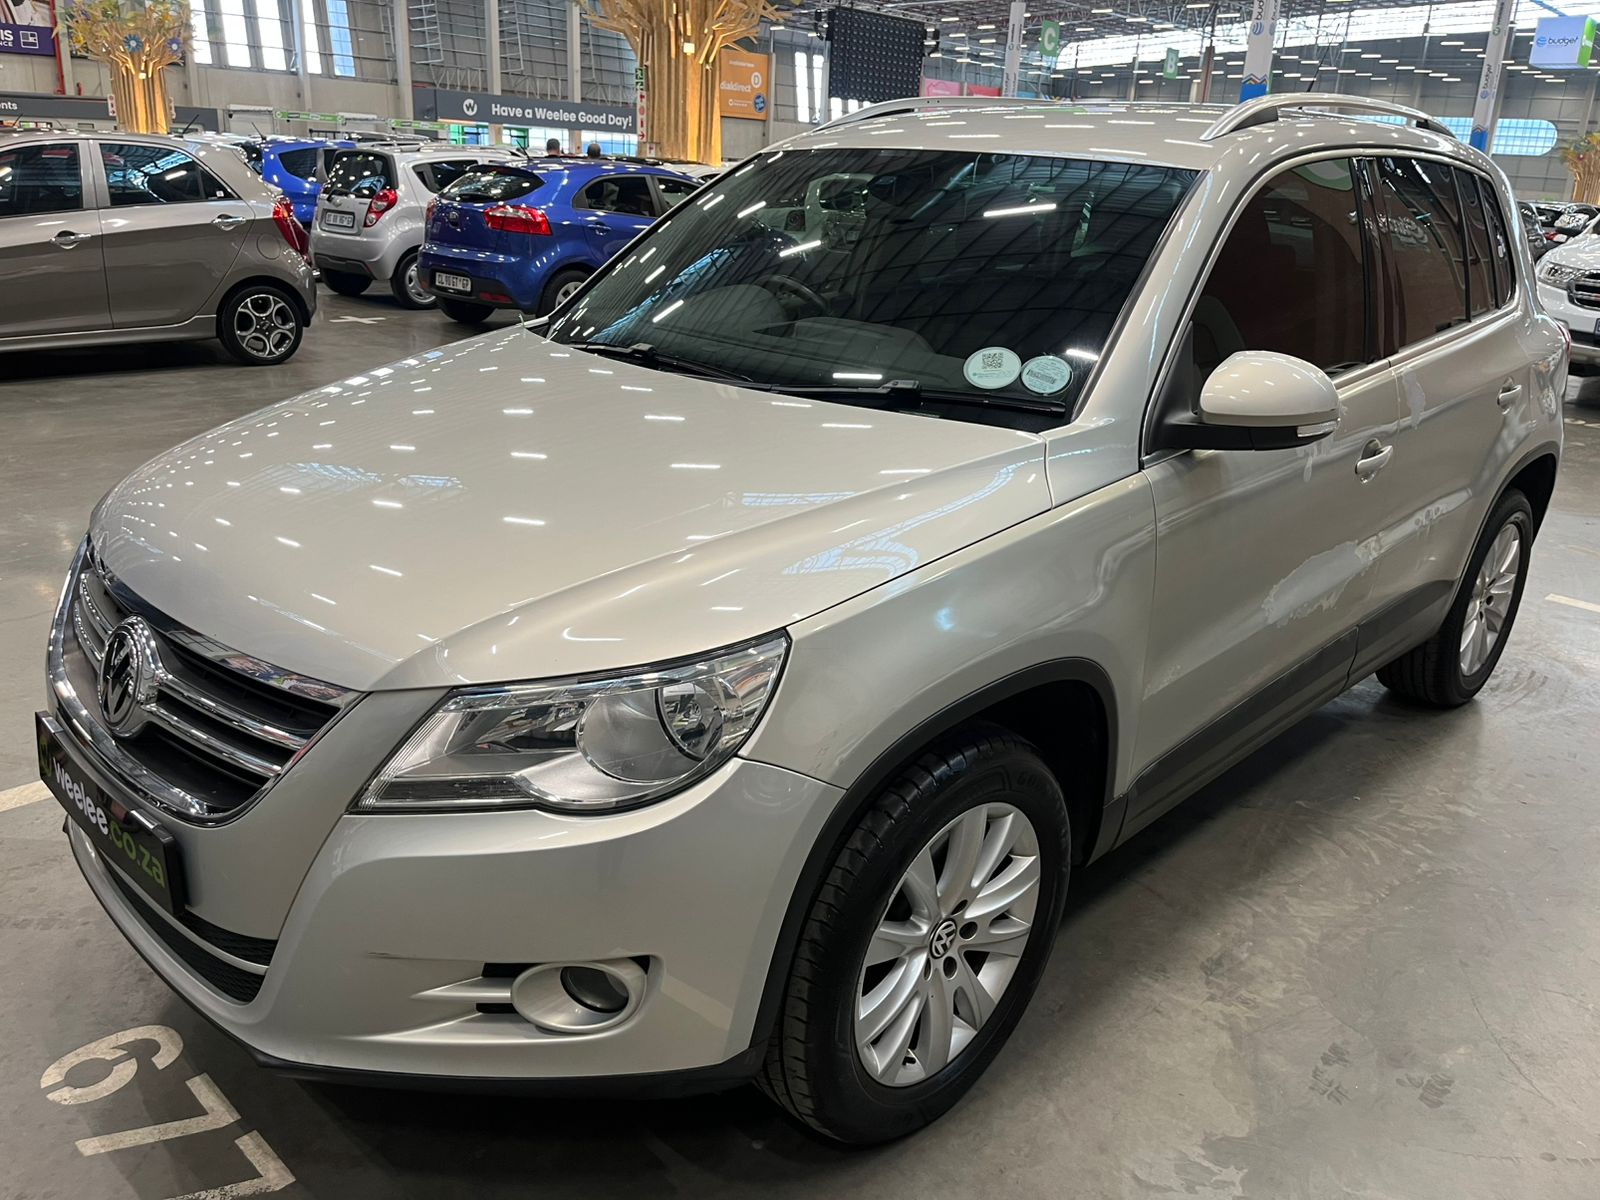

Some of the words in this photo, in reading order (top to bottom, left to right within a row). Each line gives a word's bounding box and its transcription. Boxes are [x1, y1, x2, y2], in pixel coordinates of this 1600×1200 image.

[1043, 27, 1056, 50] C
[1166, 52, 1176, 73] B
[0, 101, 18, 110] nts
[491, 103, 523, 117] Have
[524, 108, 533, 118] a
[534, 107, 577, 122] Weelee
[578, 112, 606, 125] Good
[608, 114, 632, 130] Day!
